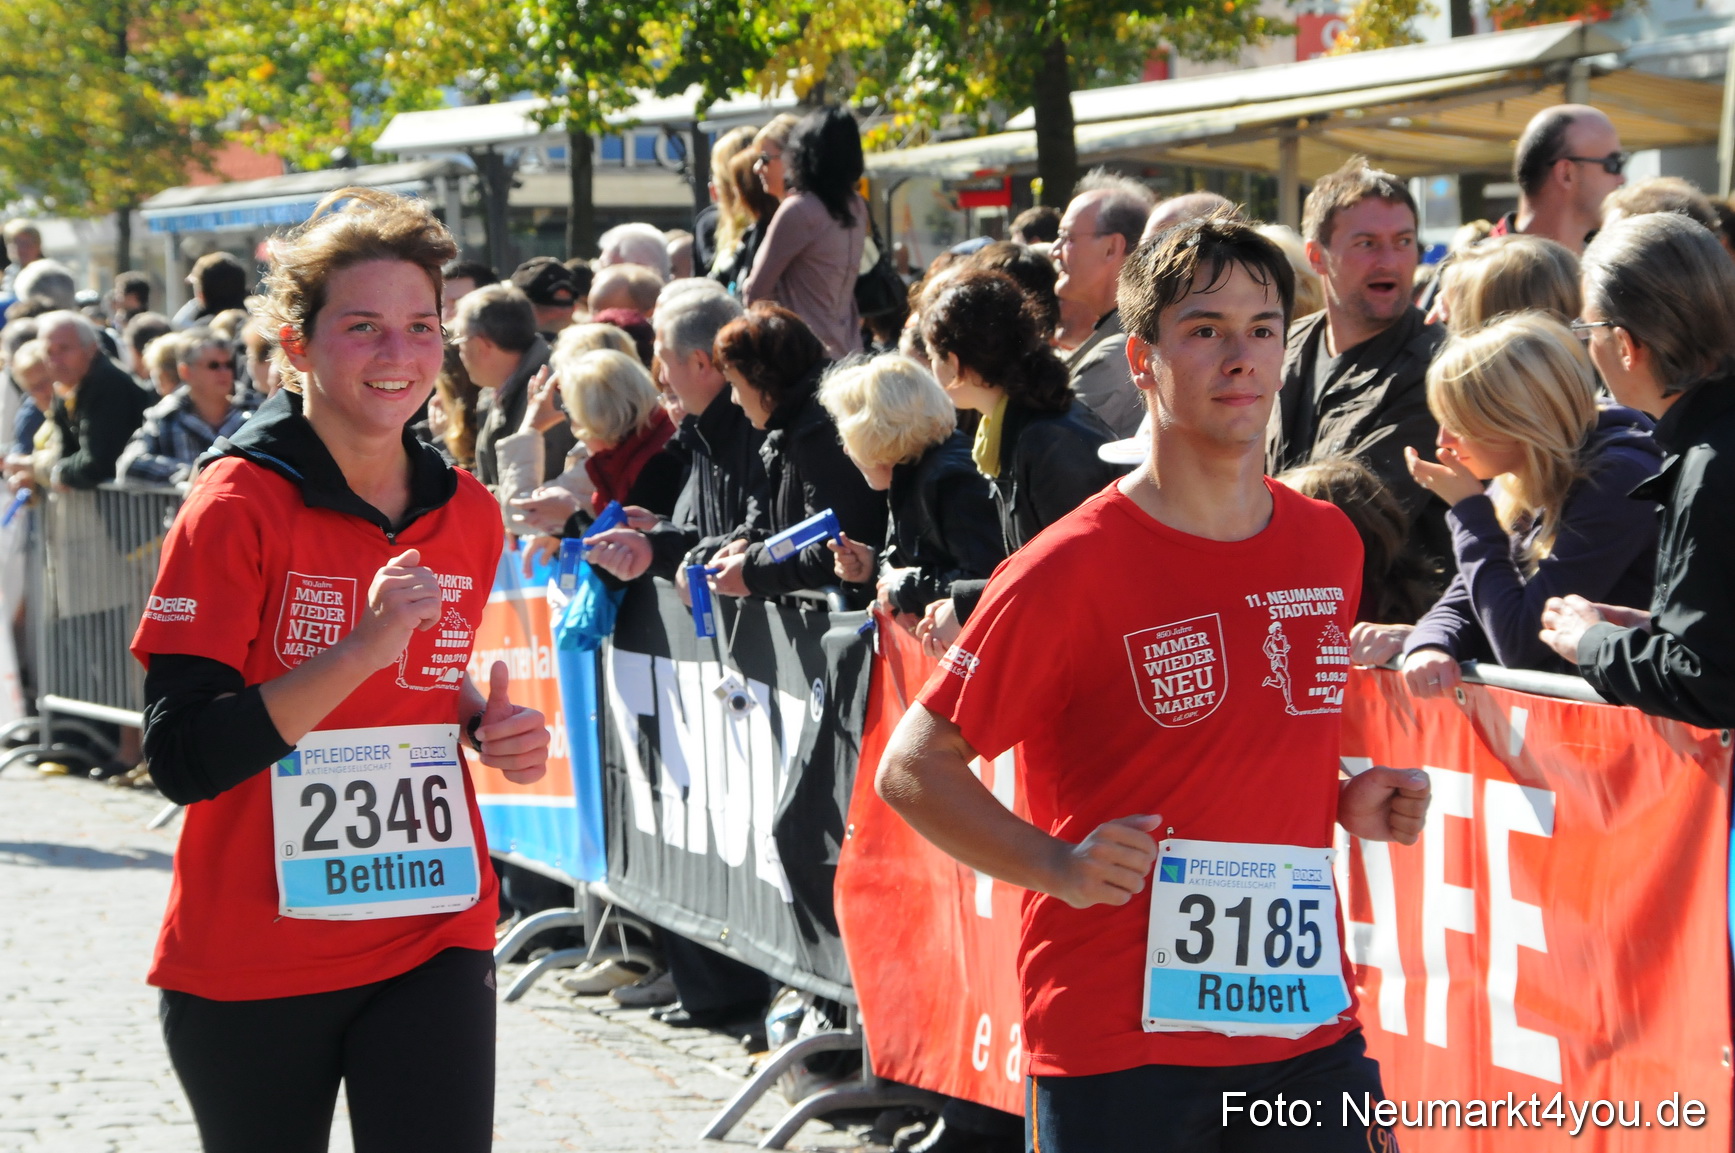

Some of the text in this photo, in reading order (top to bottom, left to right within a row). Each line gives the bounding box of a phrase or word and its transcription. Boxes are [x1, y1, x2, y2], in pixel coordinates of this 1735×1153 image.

[294, 587, 343, 606] MMER
[441, 589, 462, 602] AUF
[1268, 601, 1338, 620] STADTLAUF
[286, 618, 342, 646] NEU
[281, 642, 328, 658] MAR
[1143, 632, 1211, 660] IMMER
[1142, 648, 1217, 677] WIEDER
[1151, 665, 1214, 700] NEU
[1153, 690, 1216, 715] MARKT
[305, 745, 391, 765] PFLEIDERER
[410, 746, 447, 760] BOCK
[305, 762, 392, 776] AKTIENGESELLSCHAFT
[300, 774, 453, 852] 2346
[285, 844, 293, 857] D
[325, 853, 445, 895] Bettina
[1190, 859, 1322, 882] PFLEIDERER BOCK
[1189, 878, 1277, 890] AKTIENGESELLSCHAFT
[1175, 893, 1322, 969] 3185
[1157, 951, 1166, 964] D
[1198, 973, 1311, 1013] Robert
